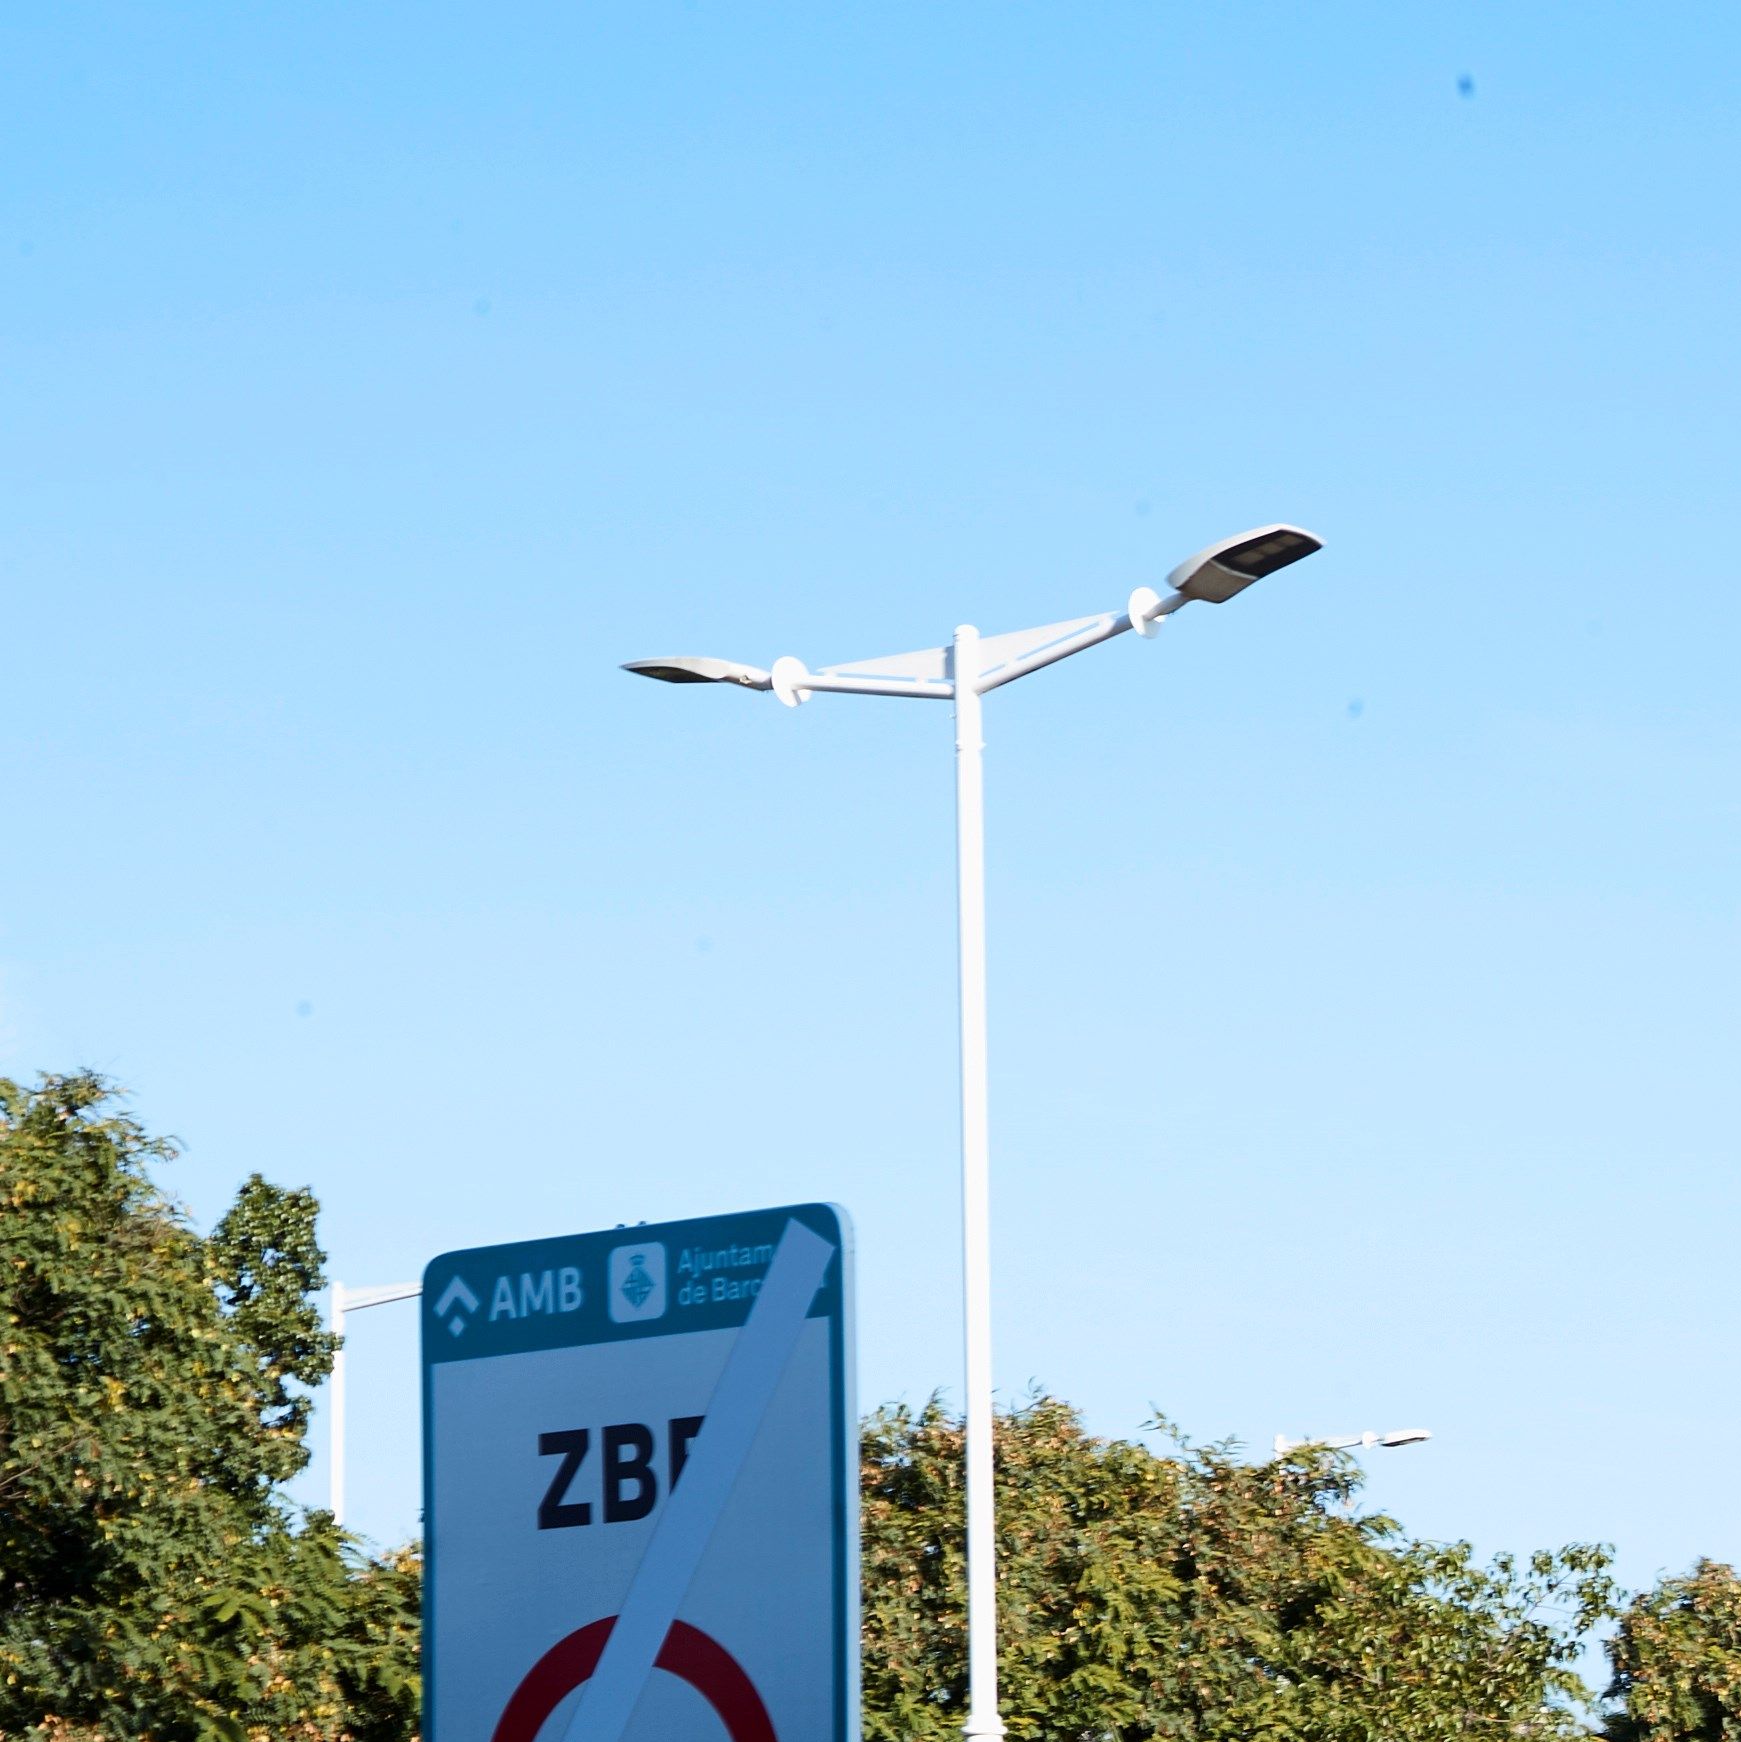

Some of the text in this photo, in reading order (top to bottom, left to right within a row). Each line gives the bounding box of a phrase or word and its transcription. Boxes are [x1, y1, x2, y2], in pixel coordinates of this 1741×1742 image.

[677, 1243, 773, 1278] Ajuntam
[488, 1266, 584, 1322] AMB
[678, 1276, 763, 1306] de Barc
